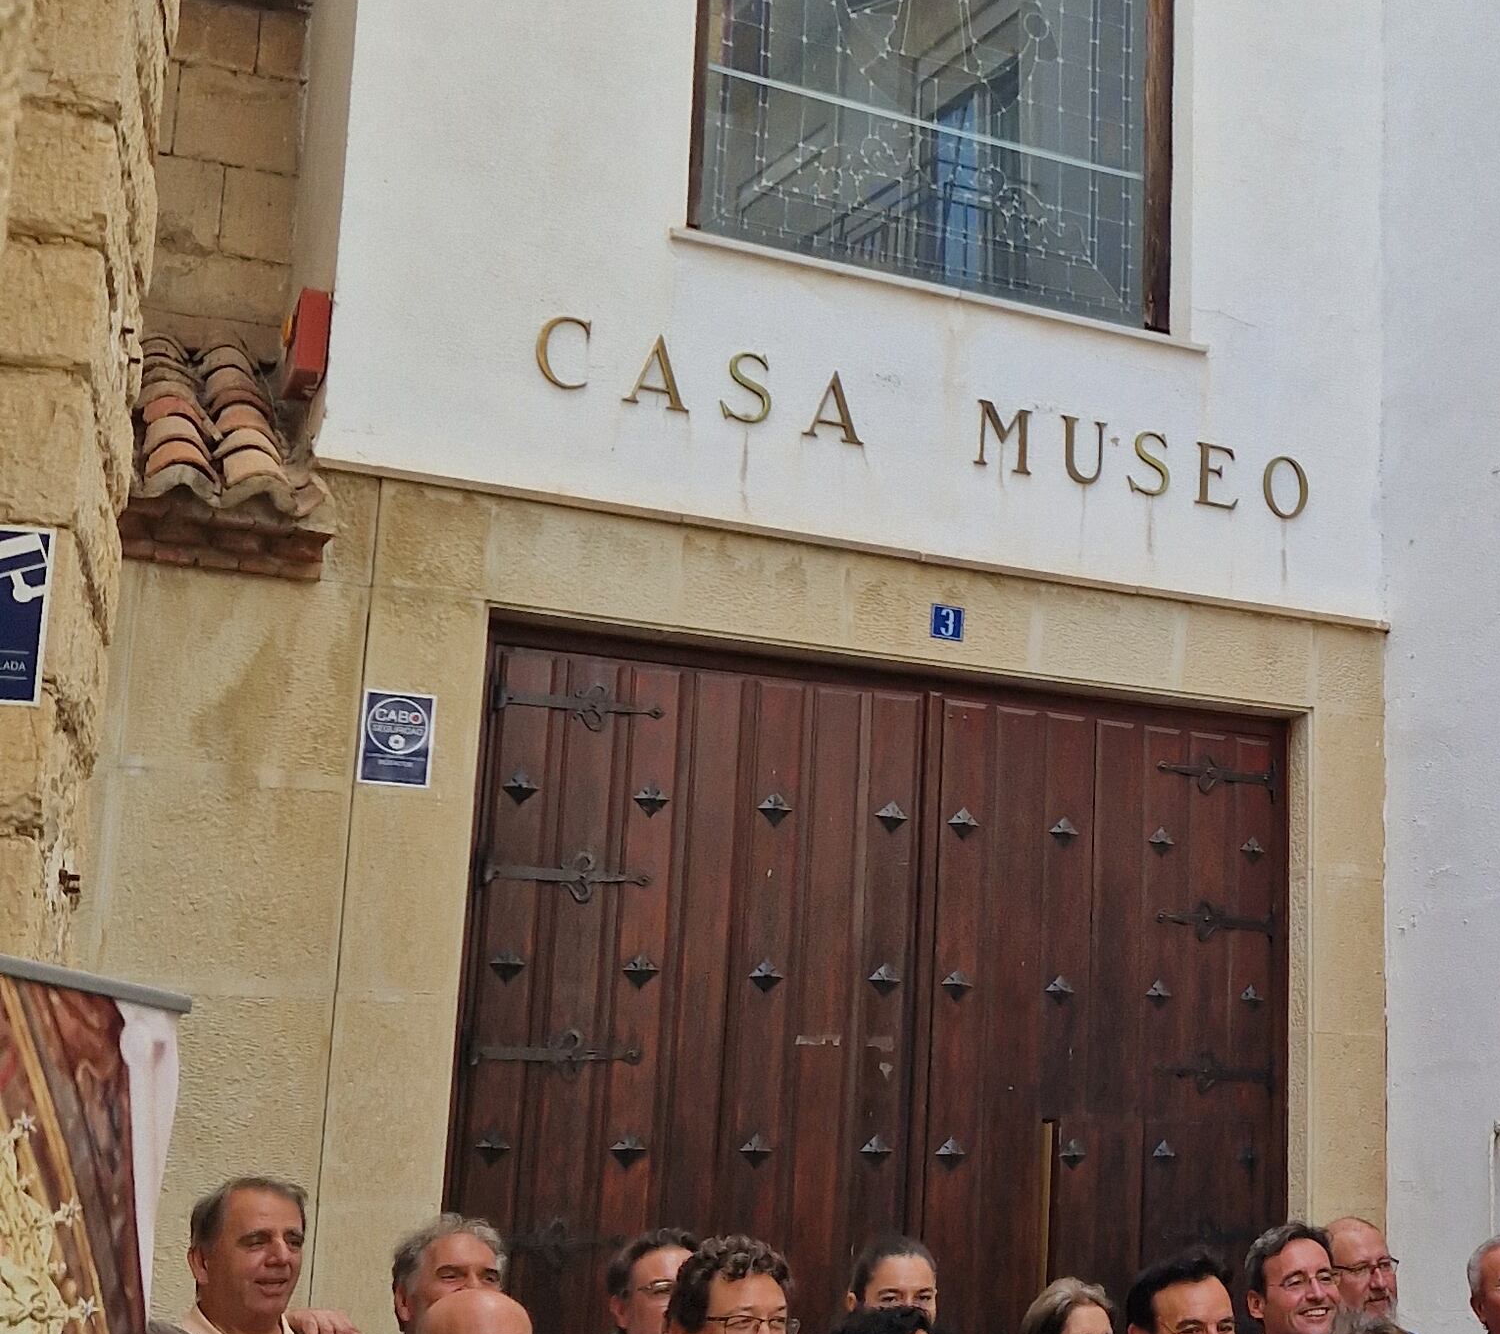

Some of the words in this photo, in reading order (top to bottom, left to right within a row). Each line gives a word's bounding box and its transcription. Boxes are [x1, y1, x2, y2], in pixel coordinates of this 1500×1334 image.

[535, 316, 864, 444] CASA
[973, 398, 1309, 519] MUSEO
[940, 609, 955, 636] 3
[375, 708, 422, 725] CABO
